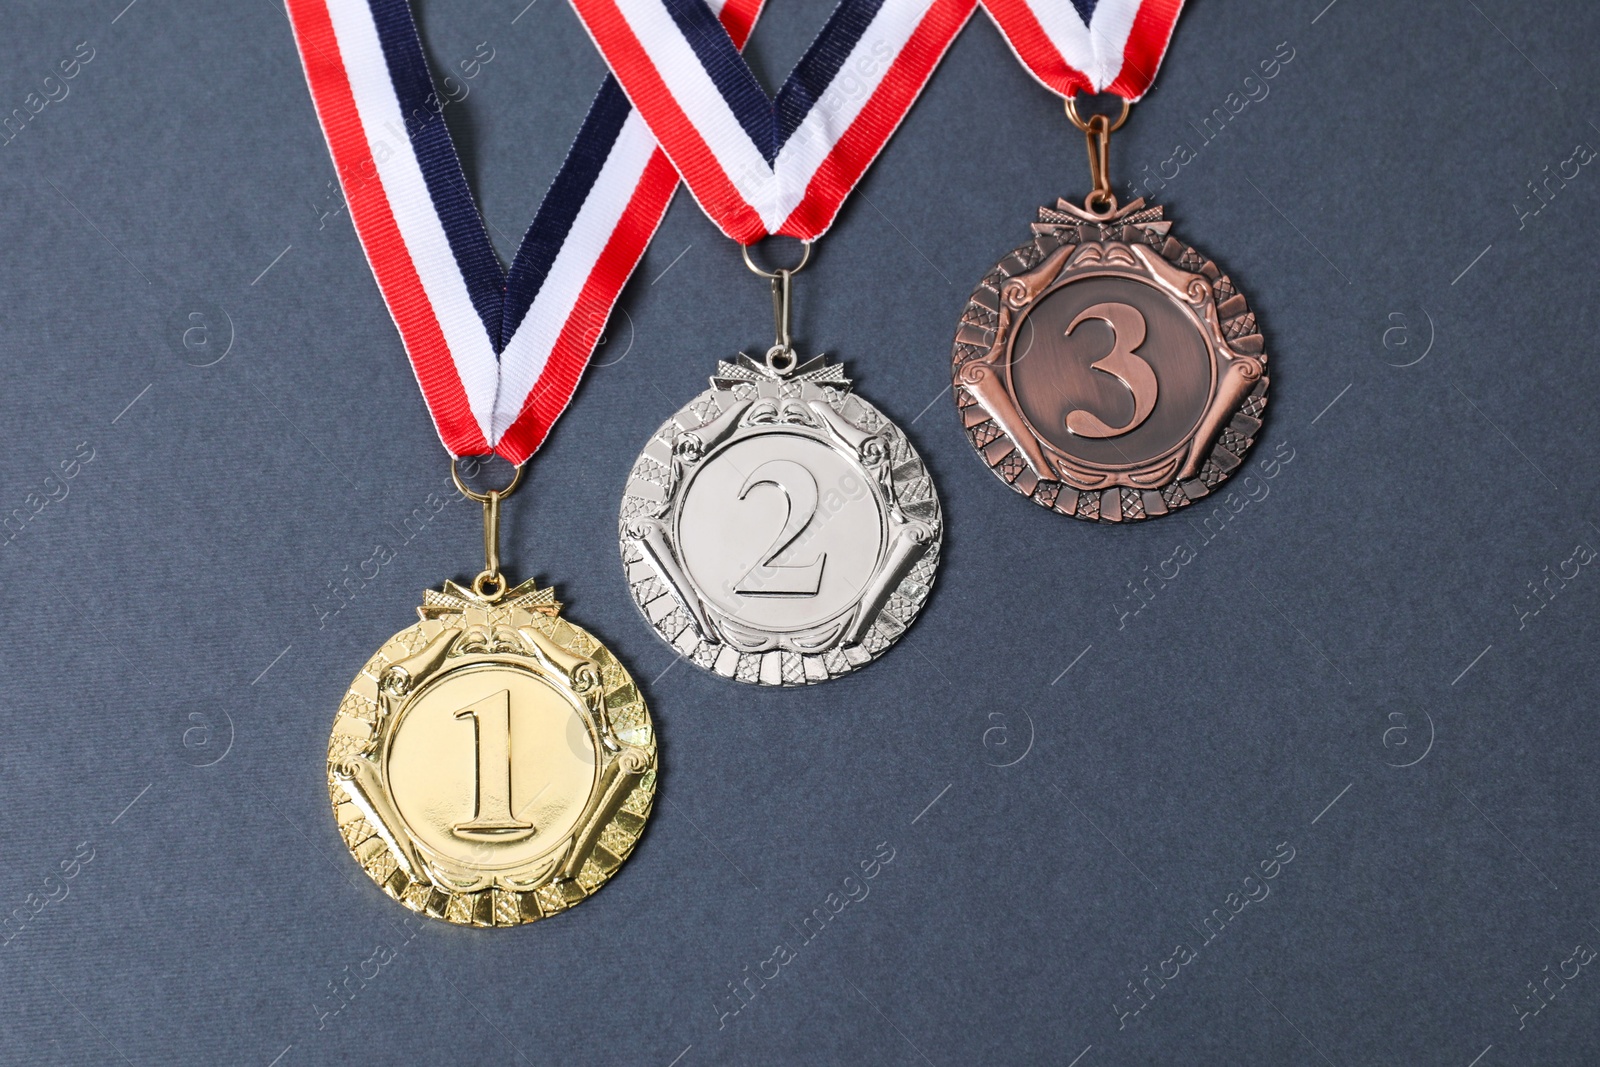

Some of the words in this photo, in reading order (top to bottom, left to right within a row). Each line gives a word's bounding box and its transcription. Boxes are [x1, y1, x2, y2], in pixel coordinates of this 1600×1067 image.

[1064, 302, 1159, 439] 3
[733, 459, 827, 598] 2
[453, 689, 534, 842] 1
